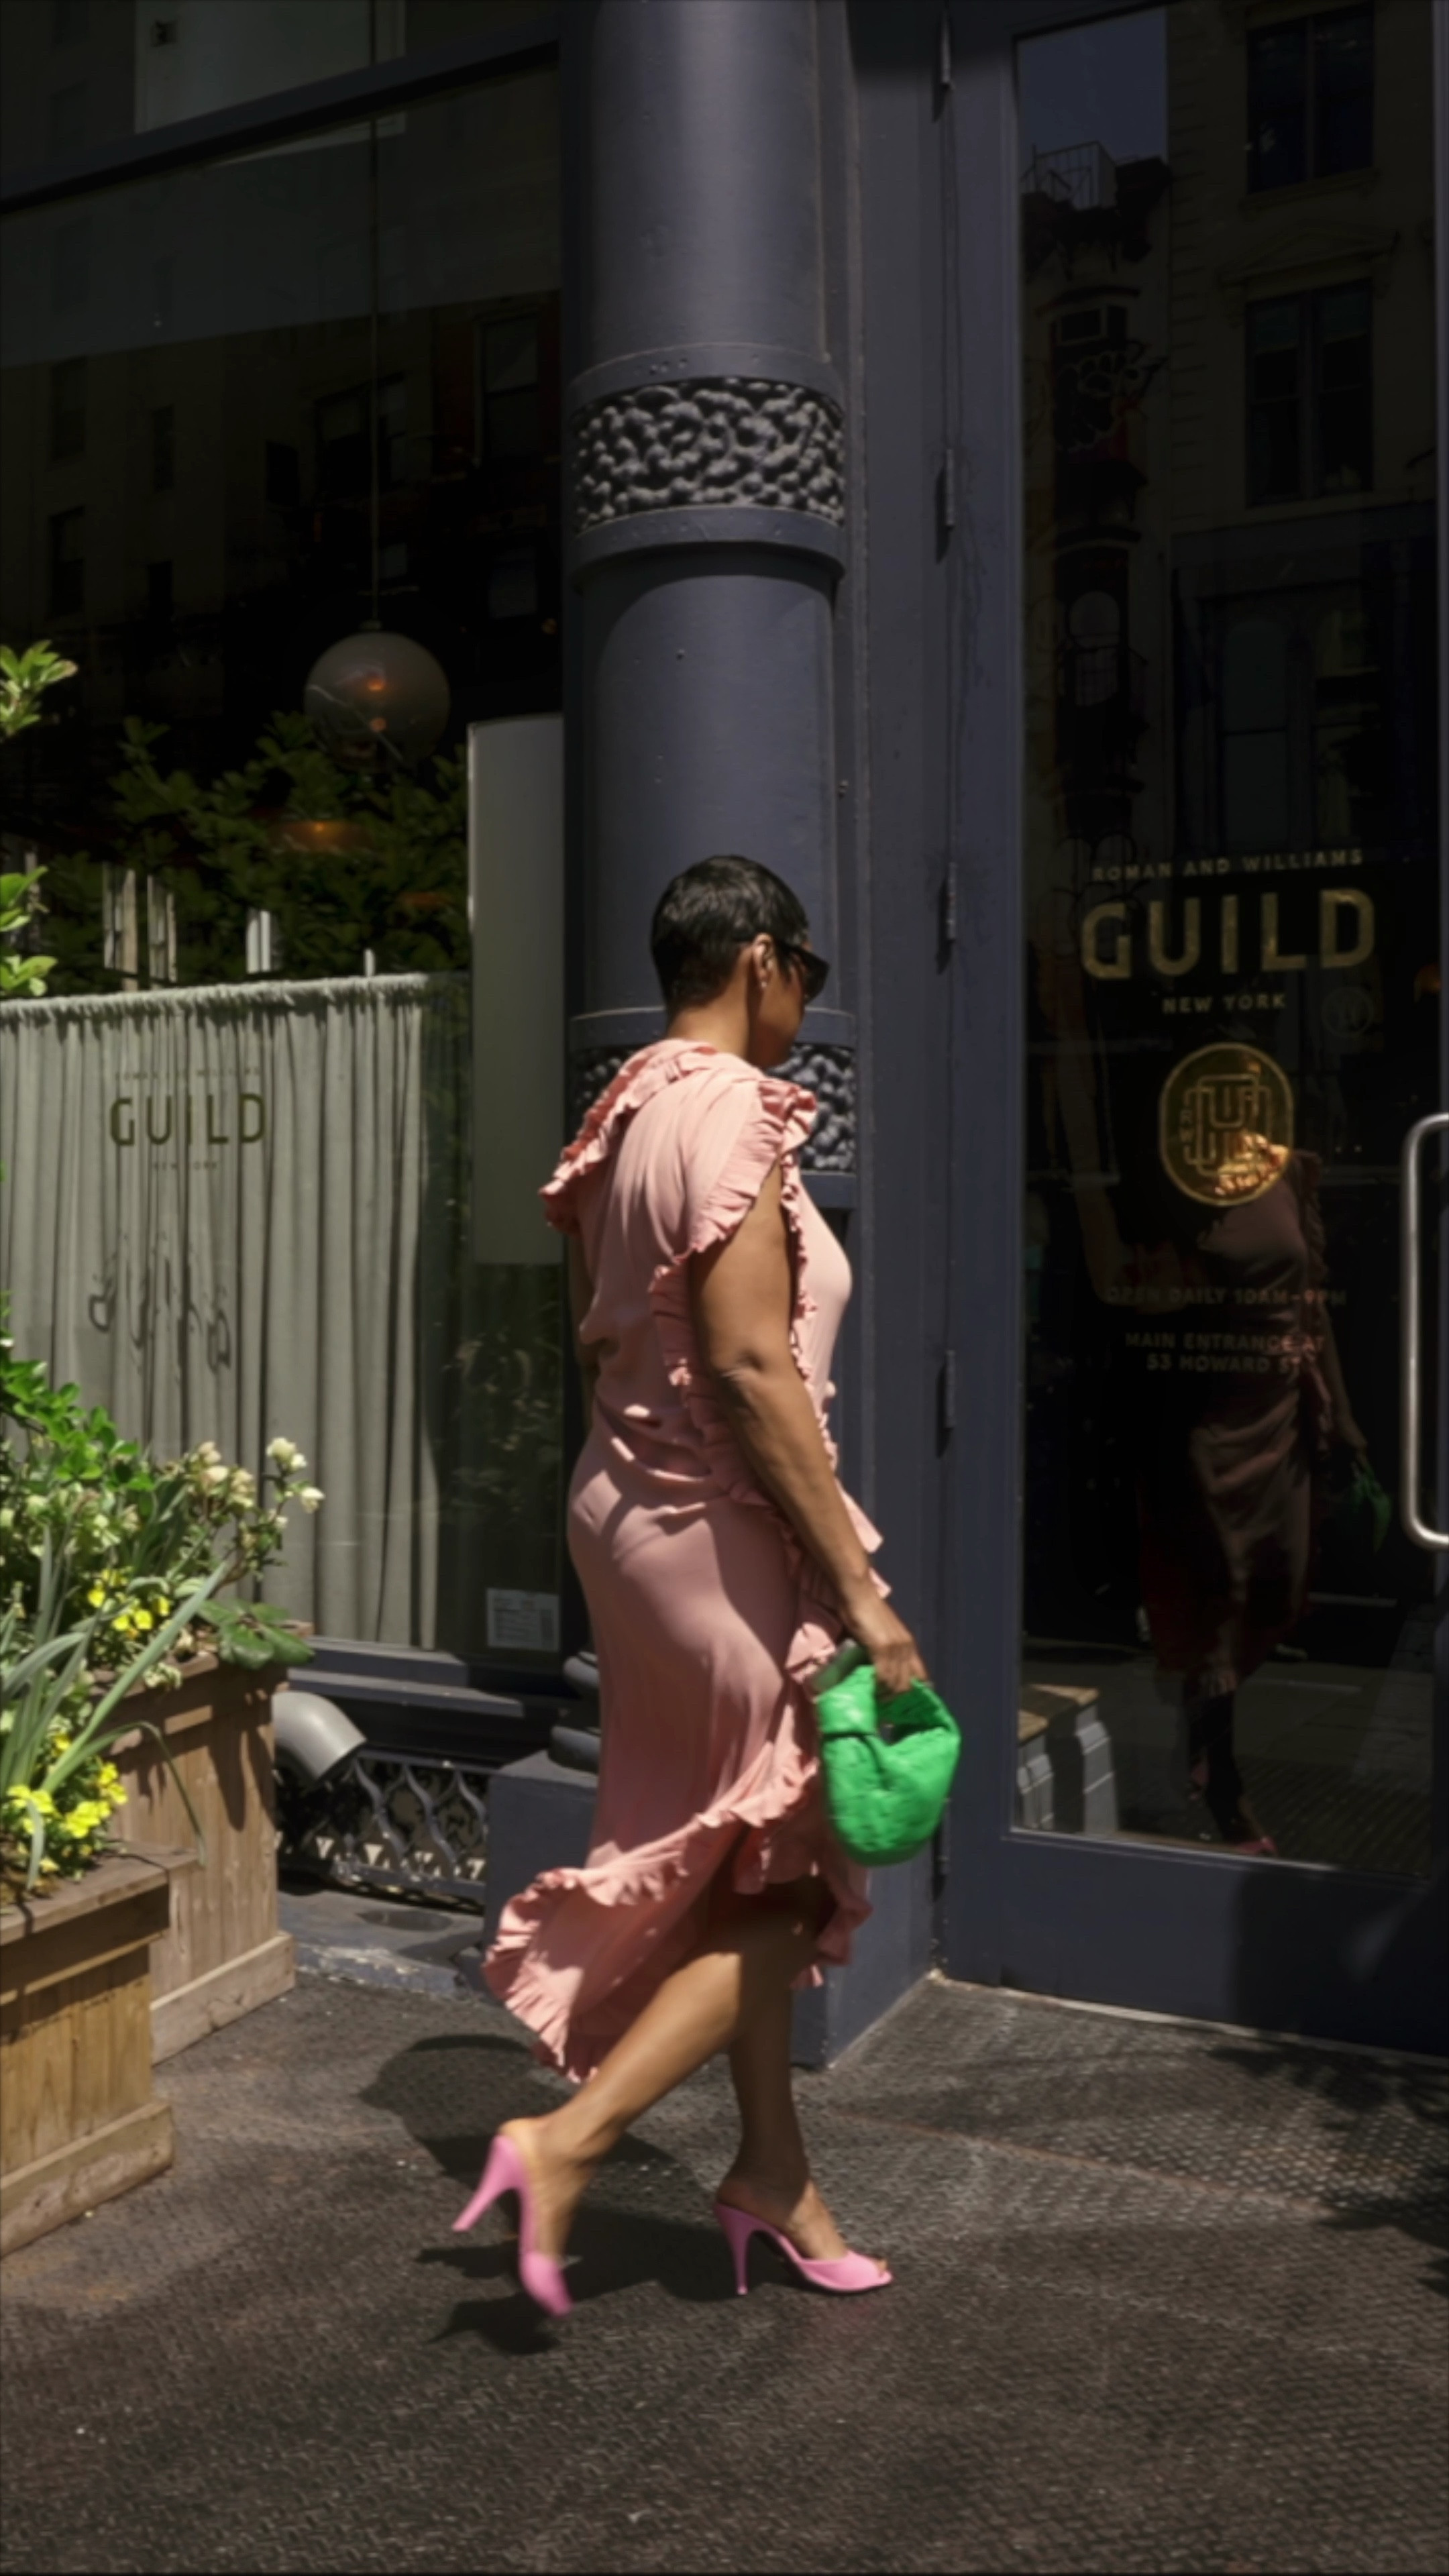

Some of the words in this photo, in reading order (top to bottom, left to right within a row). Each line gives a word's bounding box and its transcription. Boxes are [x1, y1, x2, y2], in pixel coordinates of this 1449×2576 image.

[1091, 861, 1173, 881] ROMAN
[1182, 857, 1232, 877] AND
[1242, 849, 1364, 872] WILLIAMS
[1081, 888, 1376, 979] GUILD
[1163, 997, 1214, 1014] NEW
[1223, 993, 1287, 1011] YORK
[110, 1093, 265, 1146] GUILD
[1171, 1286, 1226, 1305] DAILY
[1124, 1332, 1176, 1348] MAIN
[1183, 1333, 1295, 1352] ENTRANCE
[1146, 1352, 1171, 1371] 53
[1179, 1354, 1271, 1373] HOWARD
